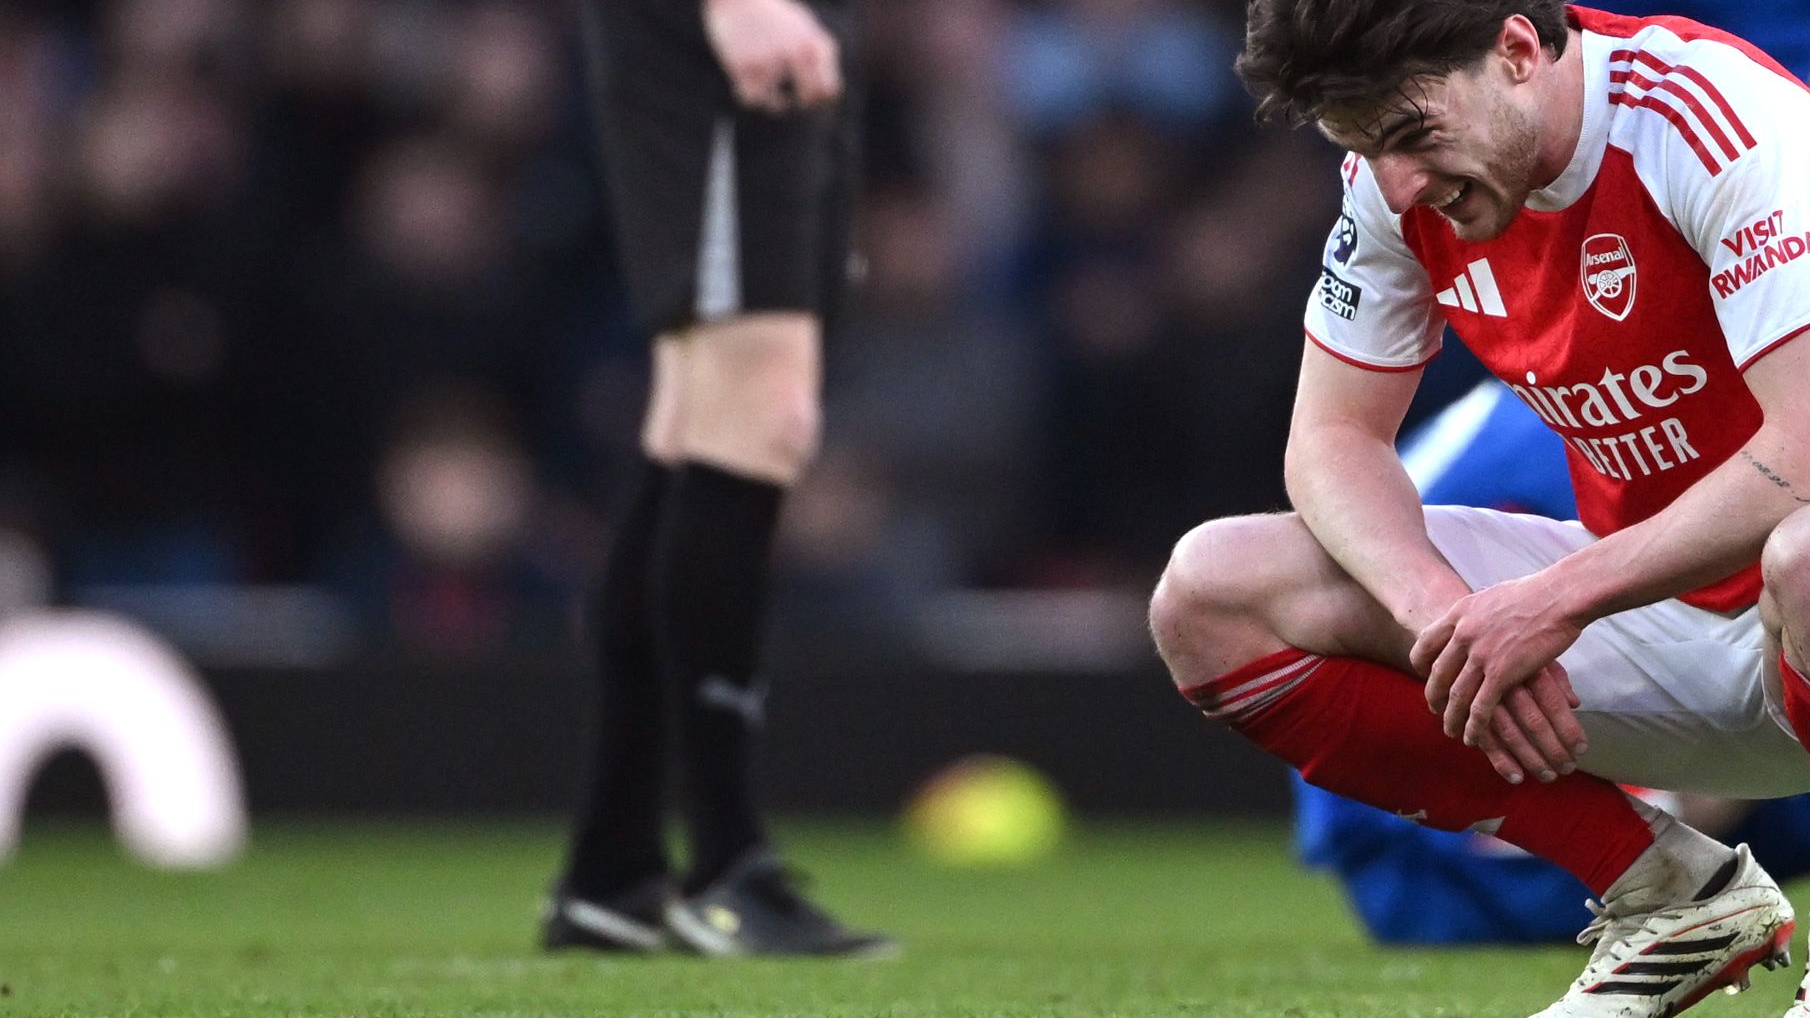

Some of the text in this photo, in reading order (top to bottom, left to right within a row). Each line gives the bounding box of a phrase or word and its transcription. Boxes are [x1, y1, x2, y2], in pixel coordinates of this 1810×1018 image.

[1720, 209, 1784, 258] VISIT
[1585, 246, 1625, 267] Arsenal
[1321, 271, 1353, 303] oom
[1318, 289, 1356, 321] cism
[1571, 417, 1700, 481] BETTER
